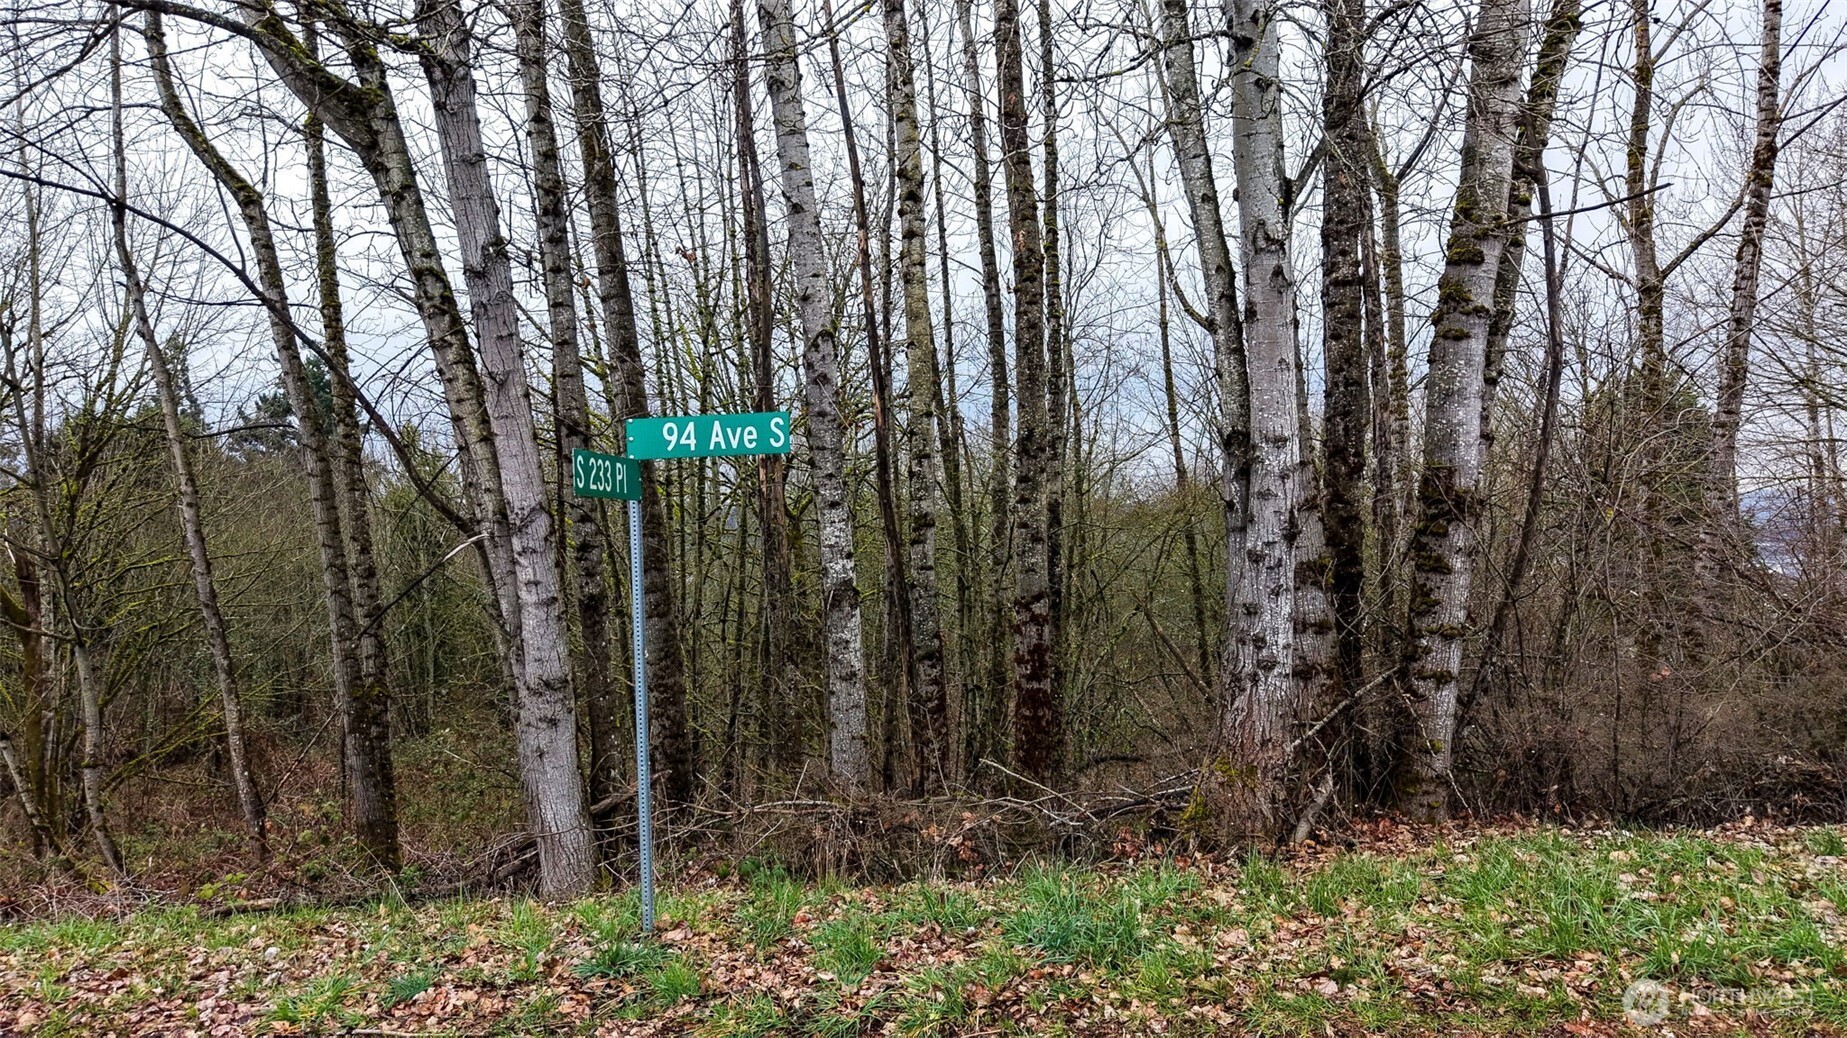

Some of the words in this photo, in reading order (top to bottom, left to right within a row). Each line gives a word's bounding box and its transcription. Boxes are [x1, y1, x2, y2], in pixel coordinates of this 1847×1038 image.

[662, 421, 696, 451] 94
[709, 420, 758, 450] Ave
[769, 417, 785, 448] S
[576, 454, 585, 489] S
[589, 457, 612, 492] 233
[616, 462, 627, 494] Pl
